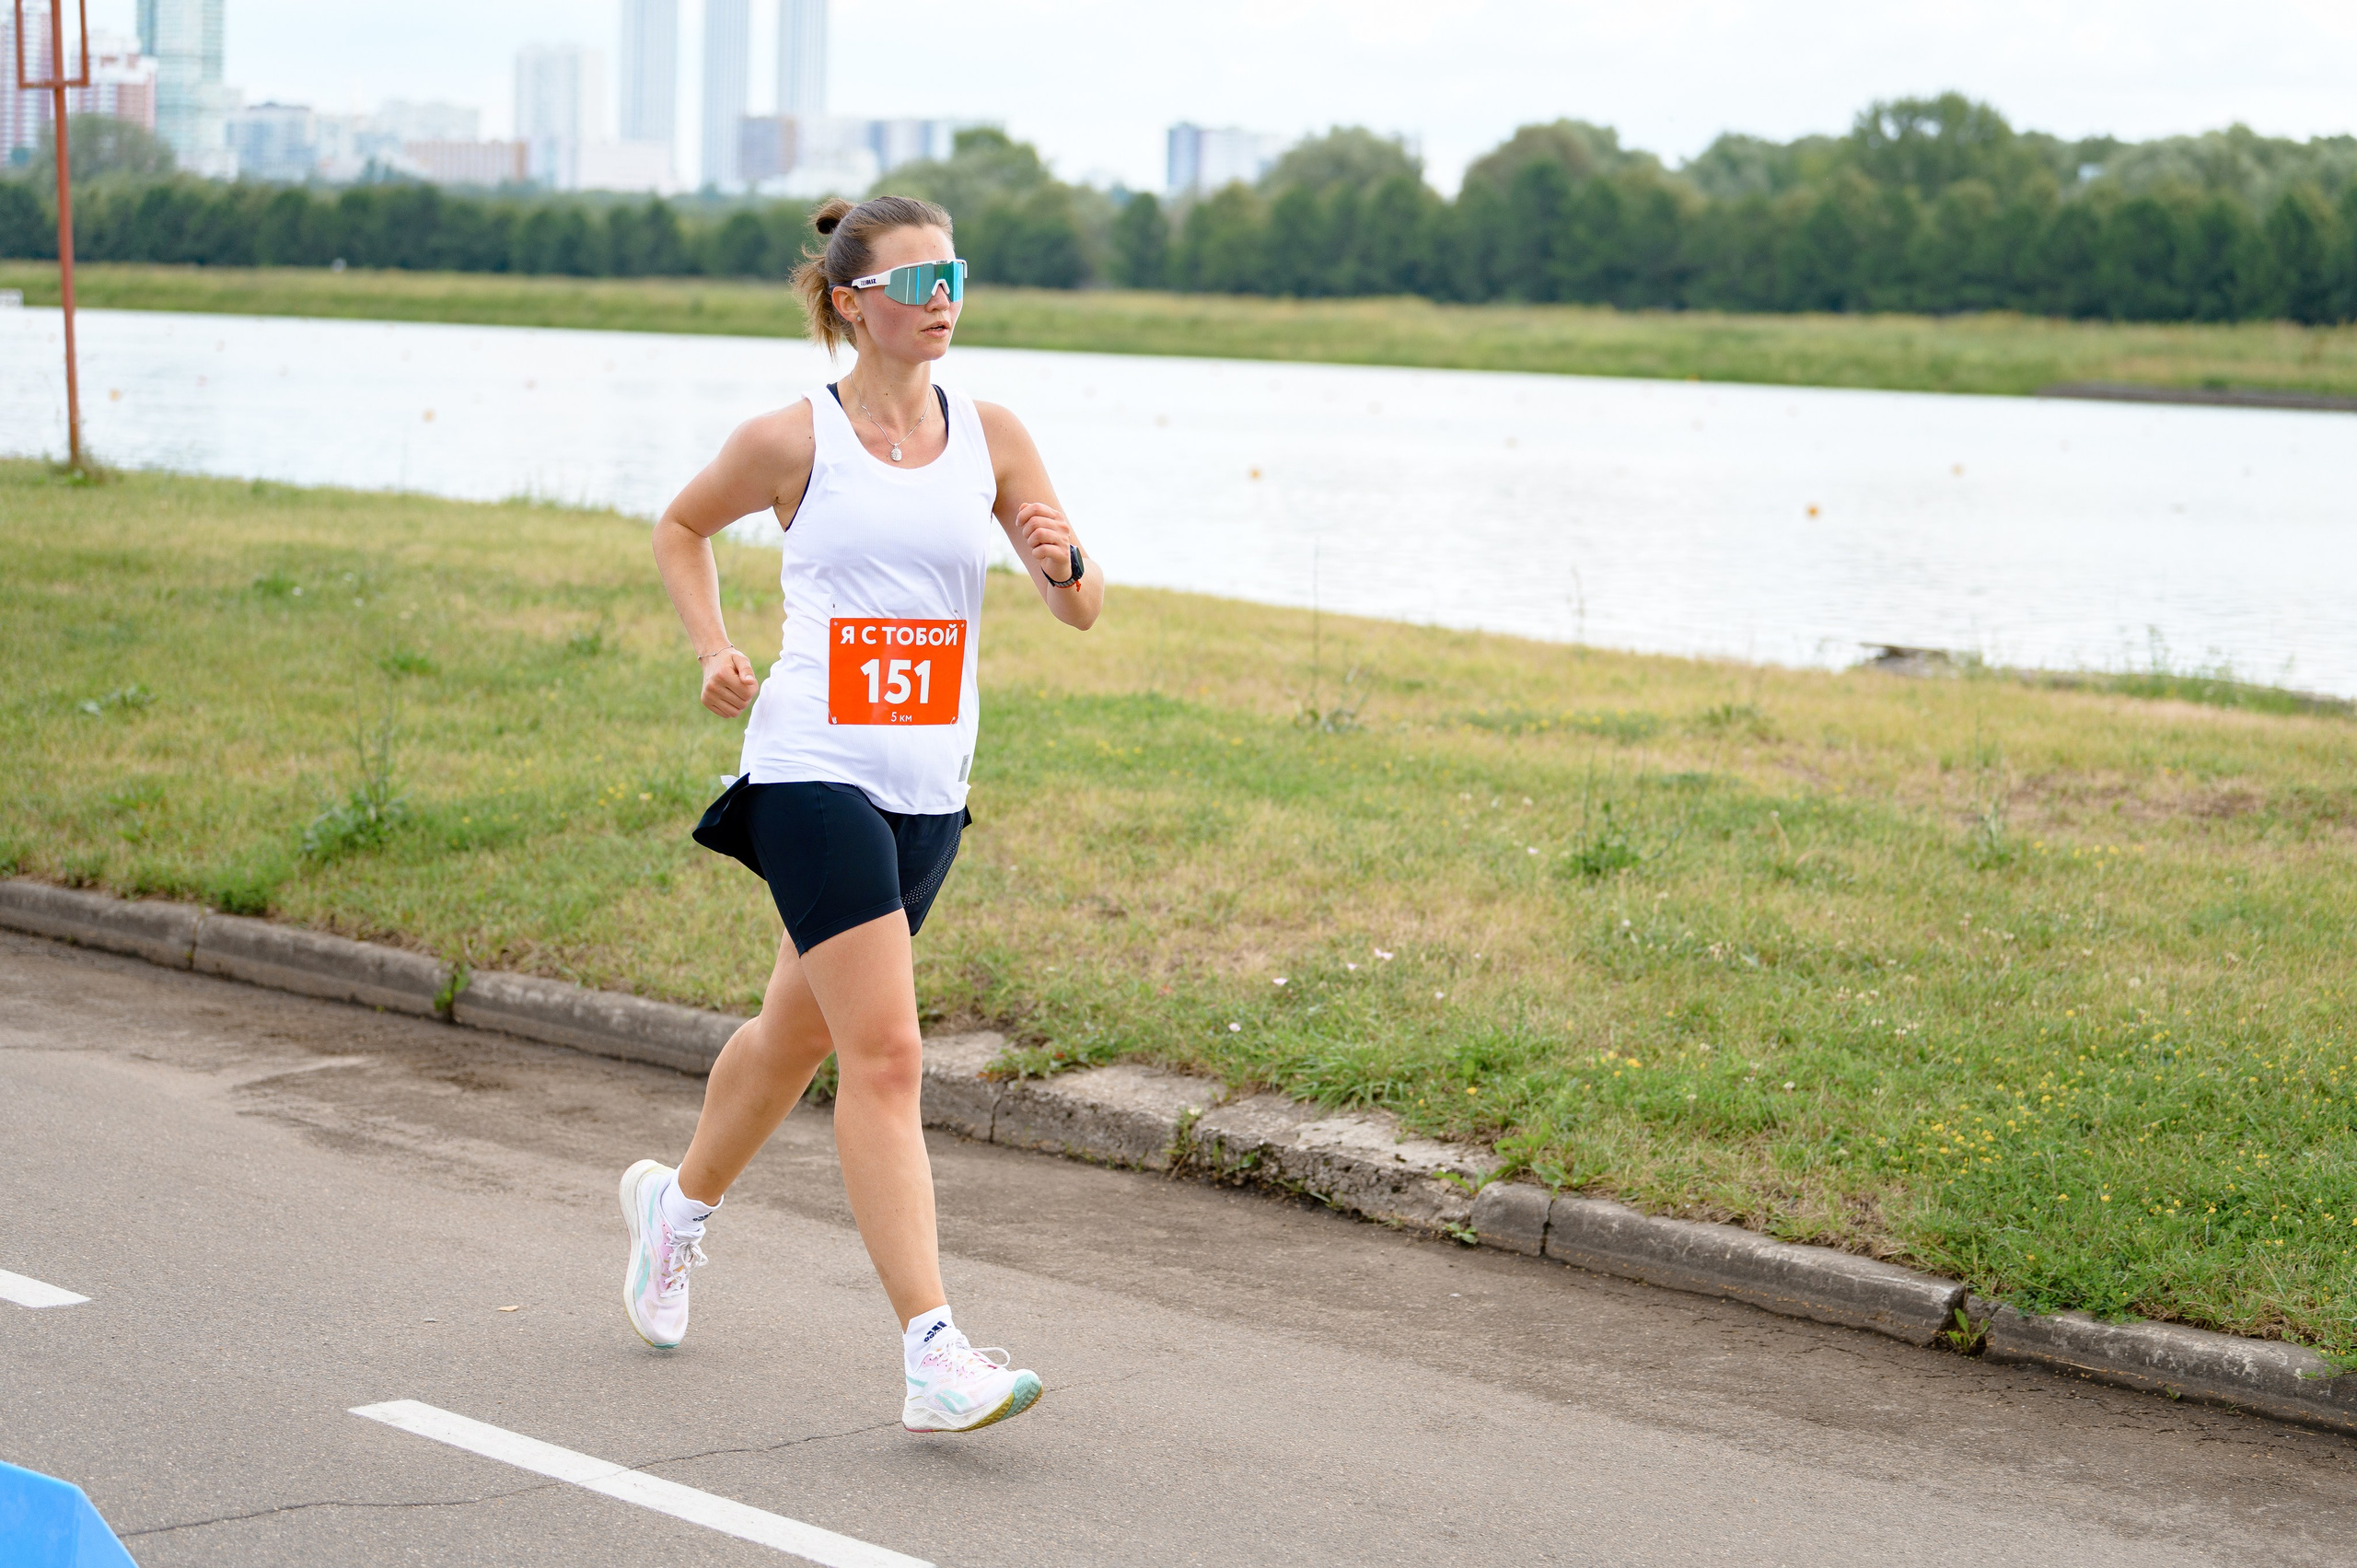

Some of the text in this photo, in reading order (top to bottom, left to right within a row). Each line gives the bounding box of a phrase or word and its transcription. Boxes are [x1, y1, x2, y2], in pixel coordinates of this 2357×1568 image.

[840, 623, 958, 646] Я С ТОБОЙ
[860, 658, 932, 704] 151
[890, 711, 898, 723] 5
